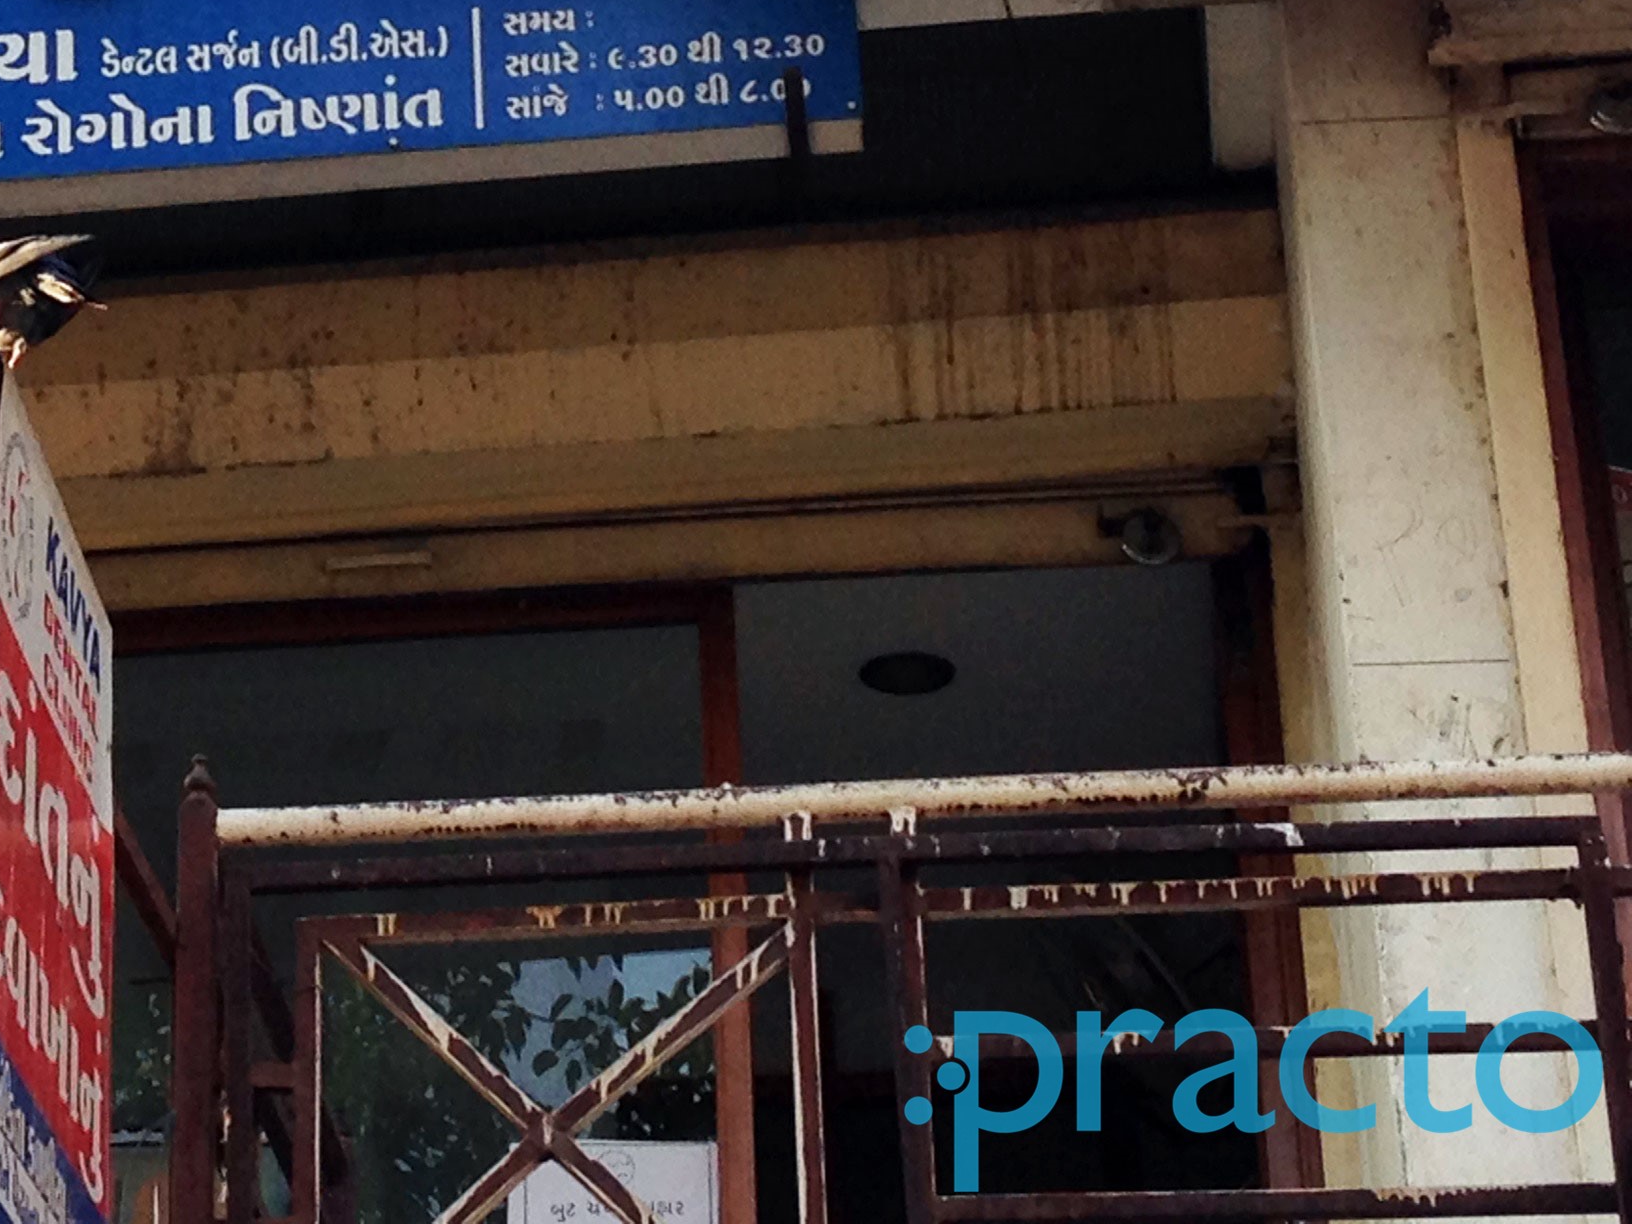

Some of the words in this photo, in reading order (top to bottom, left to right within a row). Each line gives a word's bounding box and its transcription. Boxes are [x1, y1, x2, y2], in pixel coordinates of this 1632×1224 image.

[502, 8, 576, 36] સમય
[100, 36, 178, 78] ડેન્ટલ
[185, 28, 261, 72] સર્જન
[504, 41, 580, 78] સવારે
[687, 31, 722, 65] થી
[694, 72, 730, 106] થી
[20, 92, 215, 156] રોગોના
[233, 74, 445, 143] નિષ્ણાંત
[45, 516, 101, 694] KAVYA
